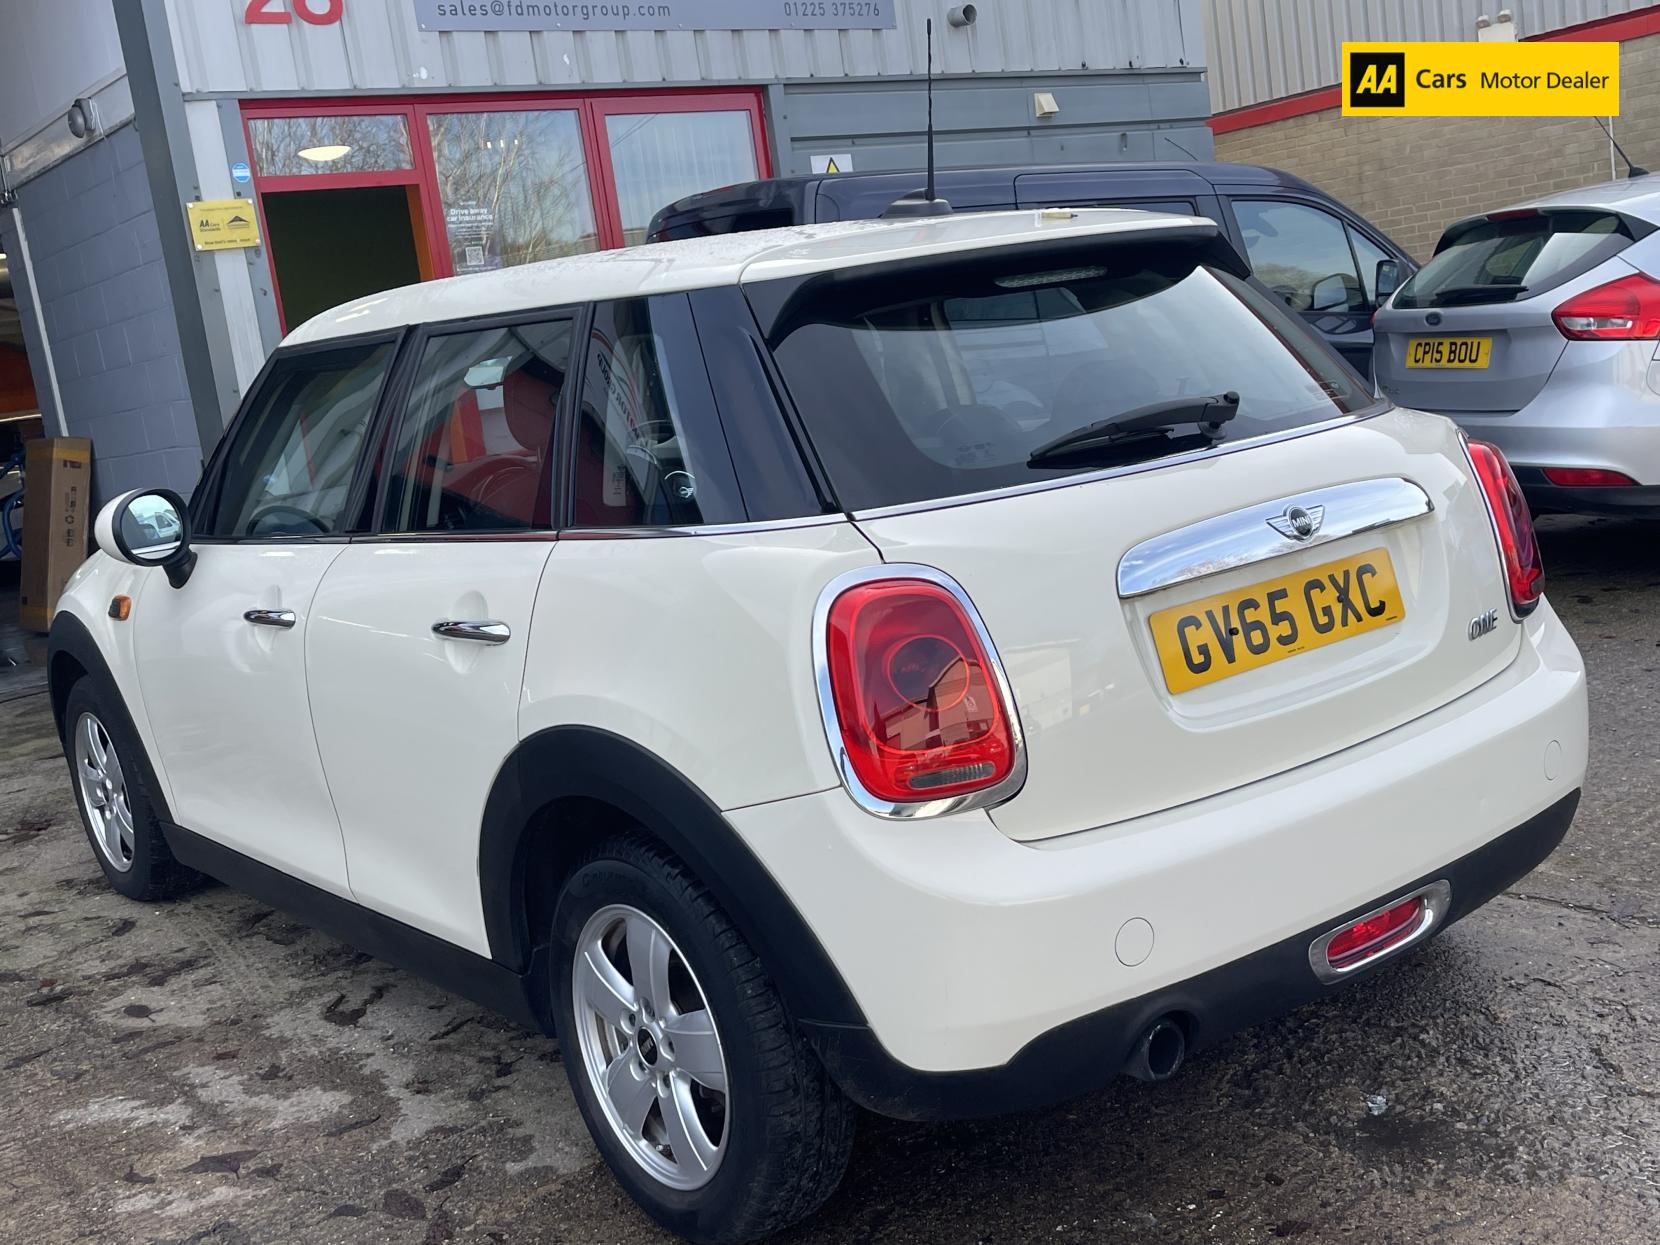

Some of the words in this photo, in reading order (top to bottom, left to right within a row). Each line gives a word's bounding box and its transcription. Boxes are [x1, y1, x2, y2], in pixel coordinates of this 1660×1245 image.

[437, 0, 671, 20] sales@fdmotorgroup.com
[784, 2, 825, 17] 01225
[832, 2, 880, 17] 375276
[1414, 342, 1443, 364] CP15
[1447, 341, 1481, 363] BOU
[1292, 516, 1311, 528] MINI
[1176, 588, 1299, 674] GV65
[1303, 563, 1387, 635] GXC
